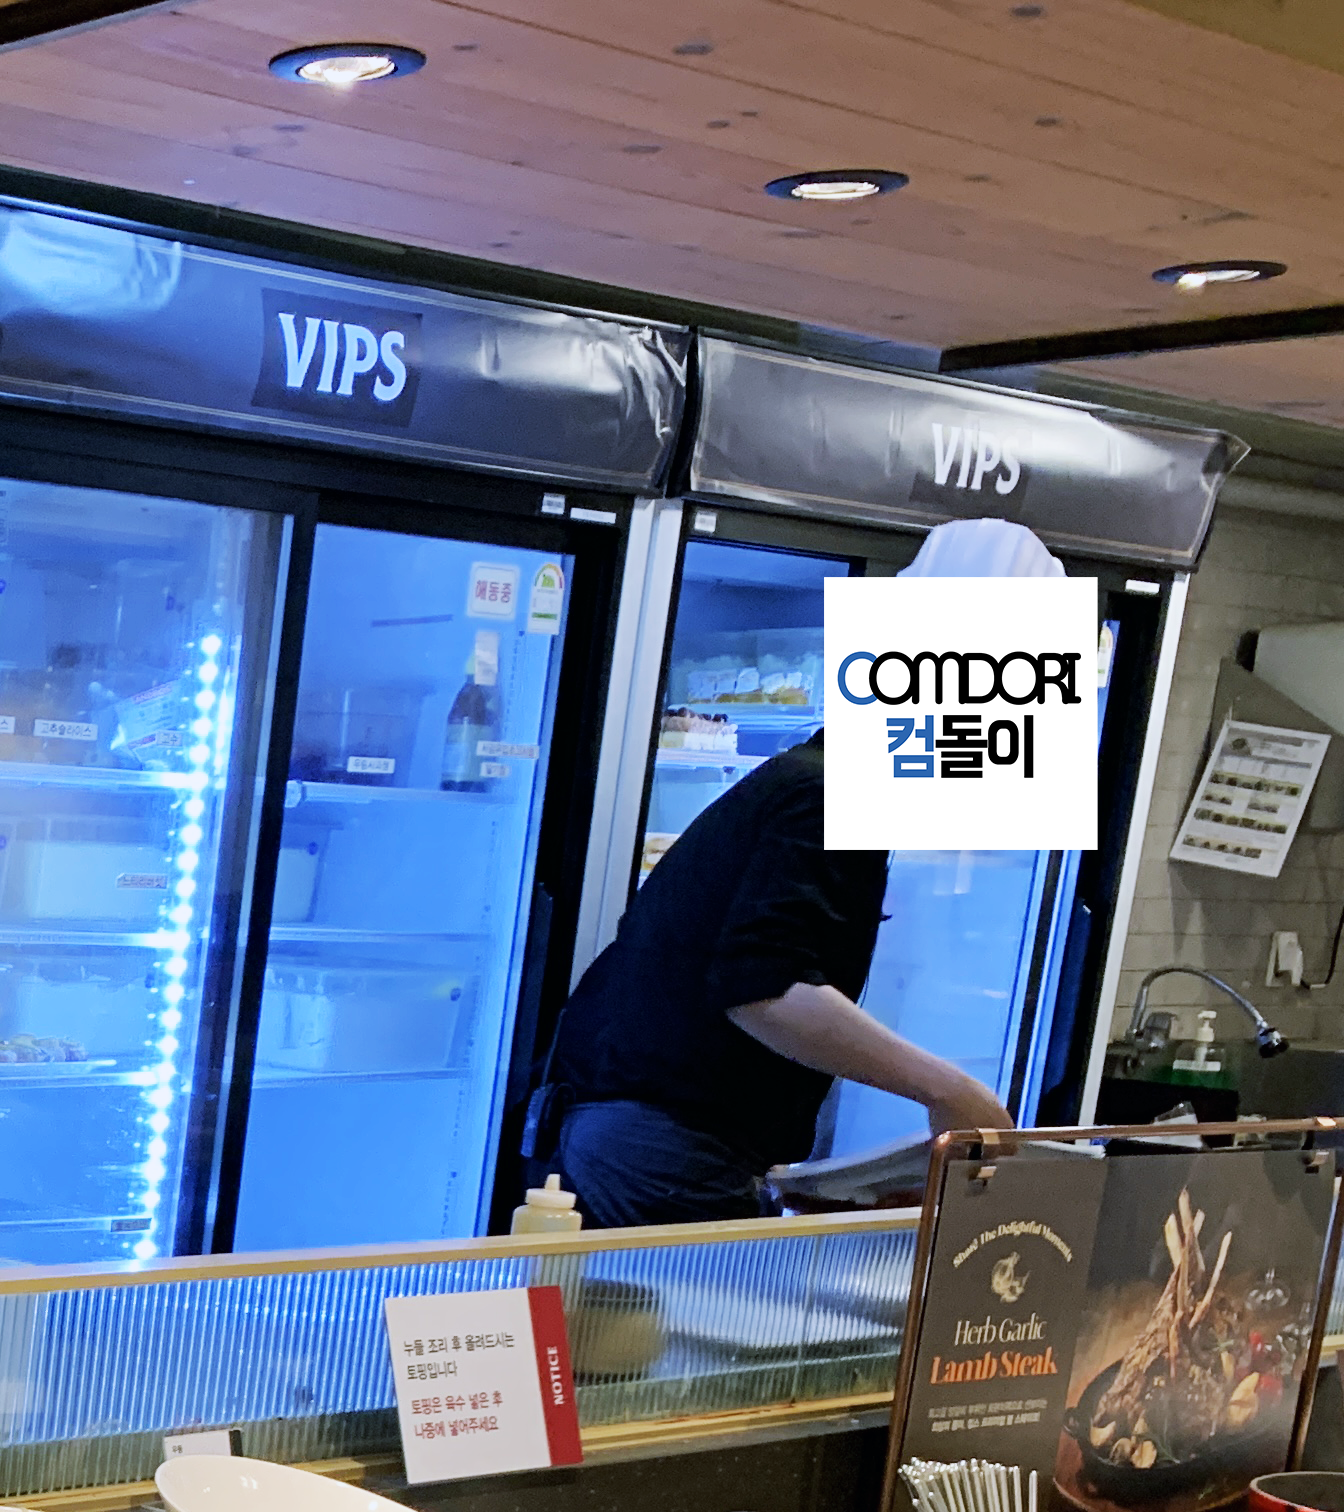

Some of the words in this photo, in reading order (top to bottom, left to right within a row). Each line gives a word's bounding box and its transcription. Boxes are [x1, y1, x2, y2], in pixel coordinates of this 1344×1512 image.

[278, 312, 407, 401] VIPS
[932, 423, 1021, 494] VIPS
[475, 580, 512, 603] 해동중
[41, 722, 92, 737] 고추슬라이스
[980, 1229, 997, 1245] The
[997, 1220, 1043, 1237] Delightful
[1042, 1225, 1073, 1262] Moments
[954, 1315, 996, 1346] Herb
[999, 1312, 1048, 1343] Garlic
[404, 1340, 424, 1358] 누들
[428, 1337, 449, 1354] 조리
[451, 1335, 462, 1353] 후
[464, 1332, 515, 1352] 올려드시는
[407, 1360, 458, 1381] 토핑입니다
[547, 1345, 565, 1405] NOTICE
[930, 1351, 999, 1385] Lamb
[999, 1346, 1059, 1378] Steak
[411, 1397, 442, 1415] 토핑은
[445, 1395, 466, 1411] 육수
[468, 1391, 490, 1410] 넣은
[492, 1390, 503, 1408] 후
[414, 1421, 446, 1440] 나중에
[448, 1415, 499, 1437] 넣어주세요
